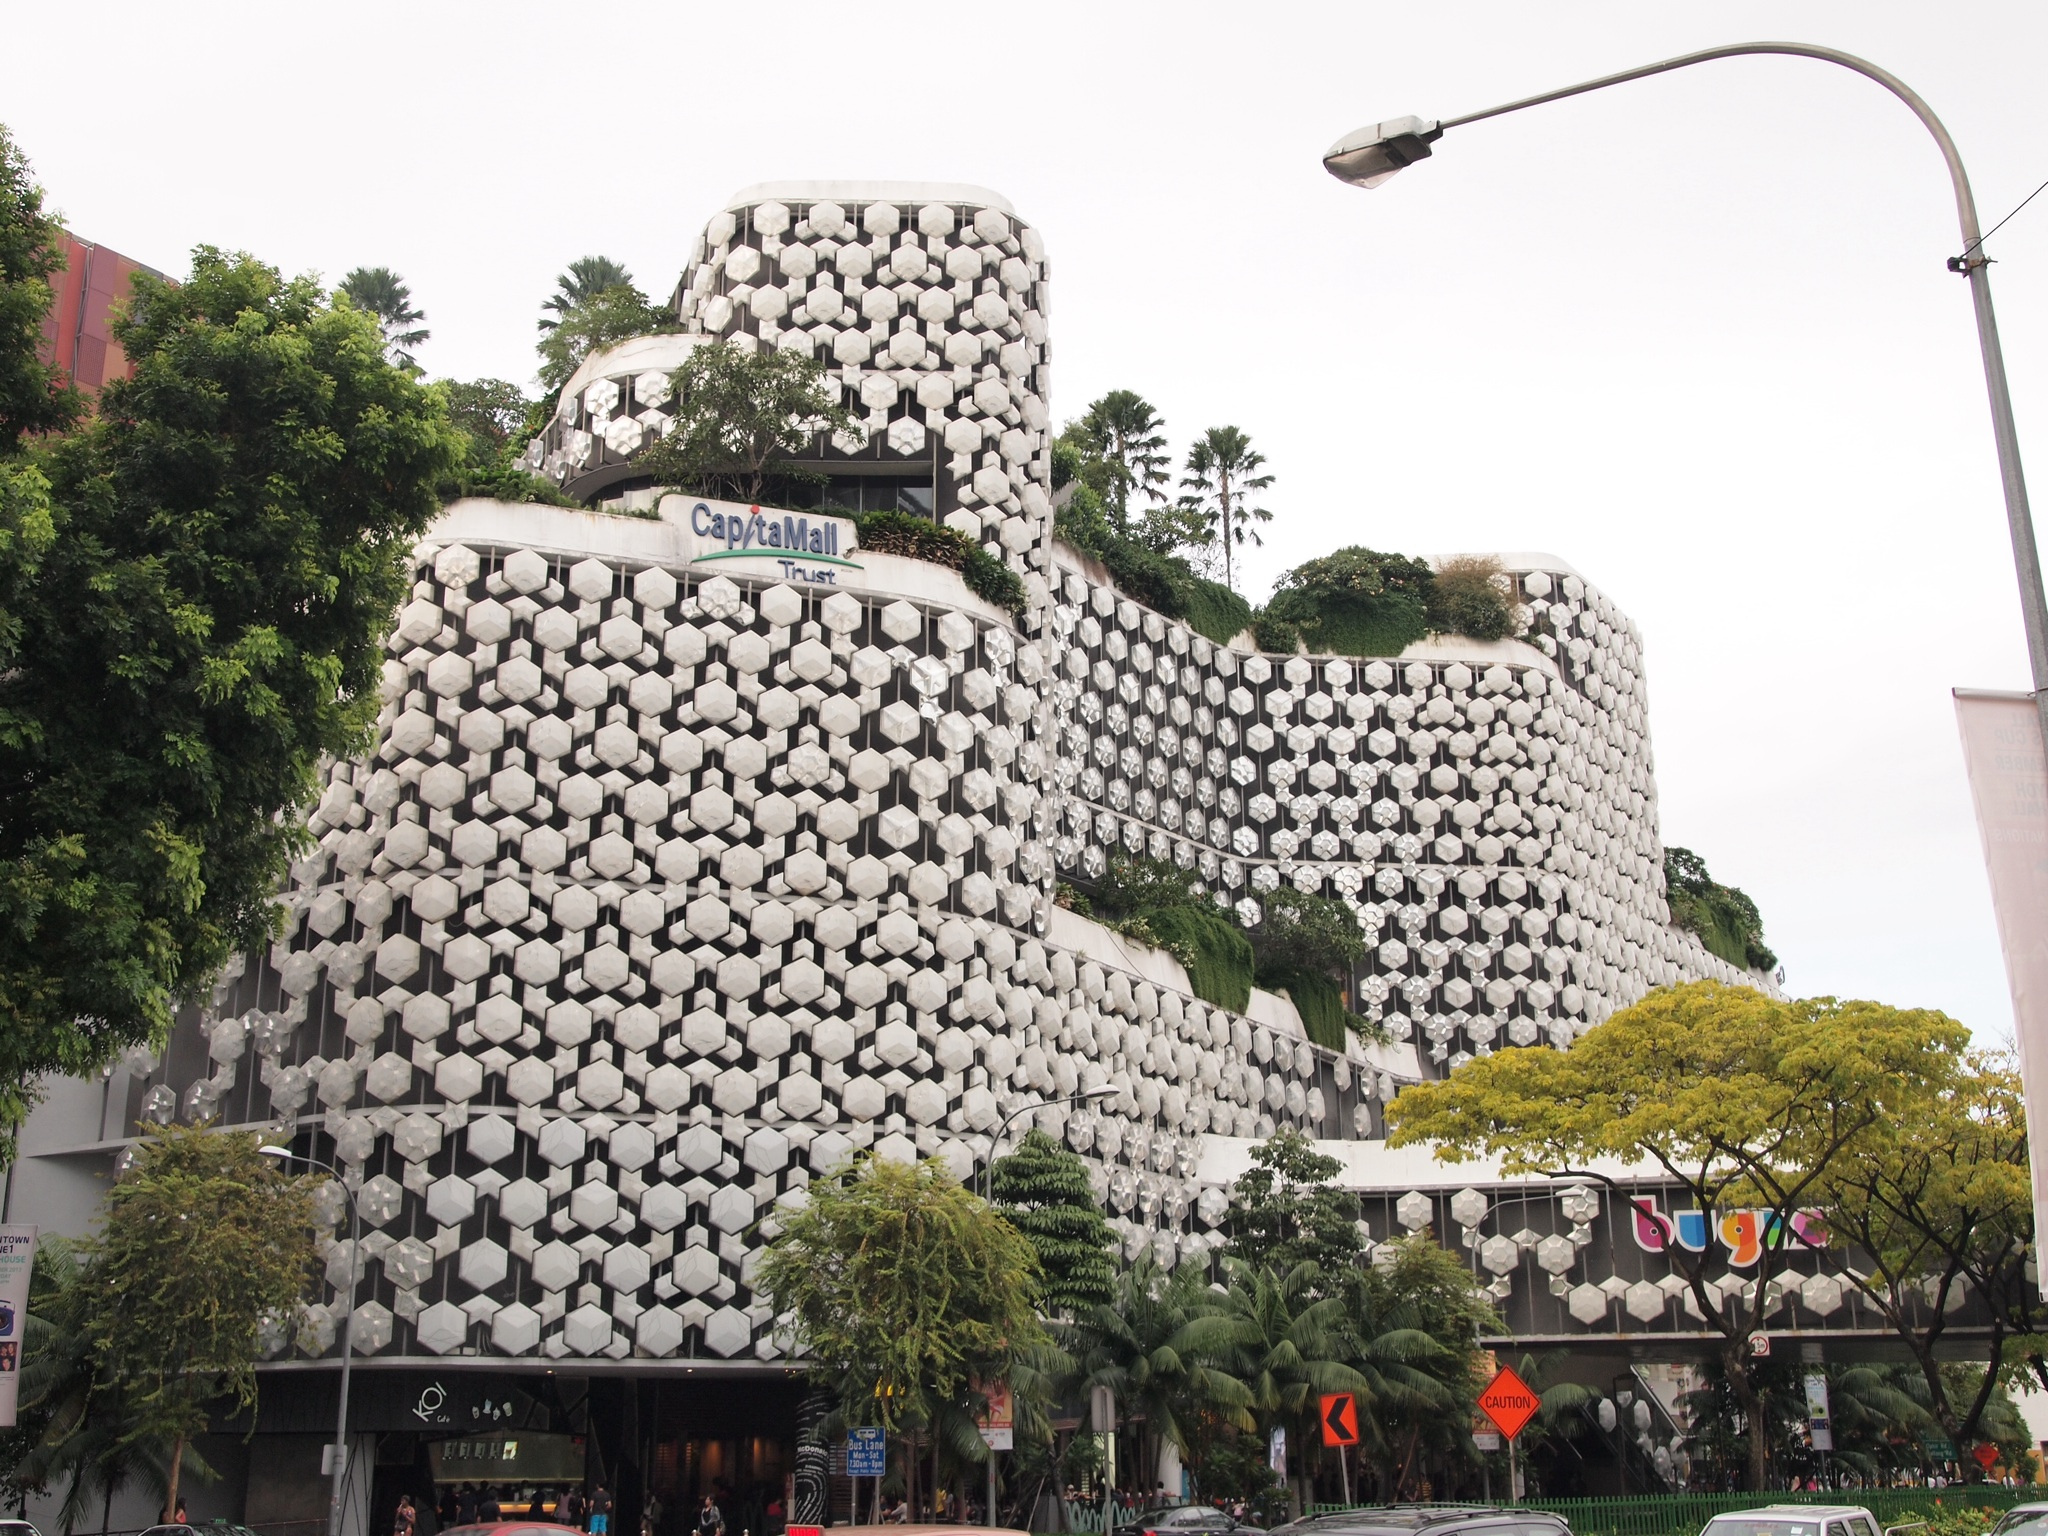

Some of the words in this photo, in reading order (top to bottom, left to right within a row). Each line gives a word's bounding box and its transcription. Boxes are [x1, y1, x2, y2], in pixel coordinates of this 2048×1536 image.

[691, 503, 838, 555] CapitaMall
[777, 559, 836, 585] Trust
[412, 1381, 447, 1422] KOI
[1485, 1395, 1531, 1409] CAUTION
[849, 1439, 863, 1450] Bus
[865, 1439, 884, 1450] Lane
